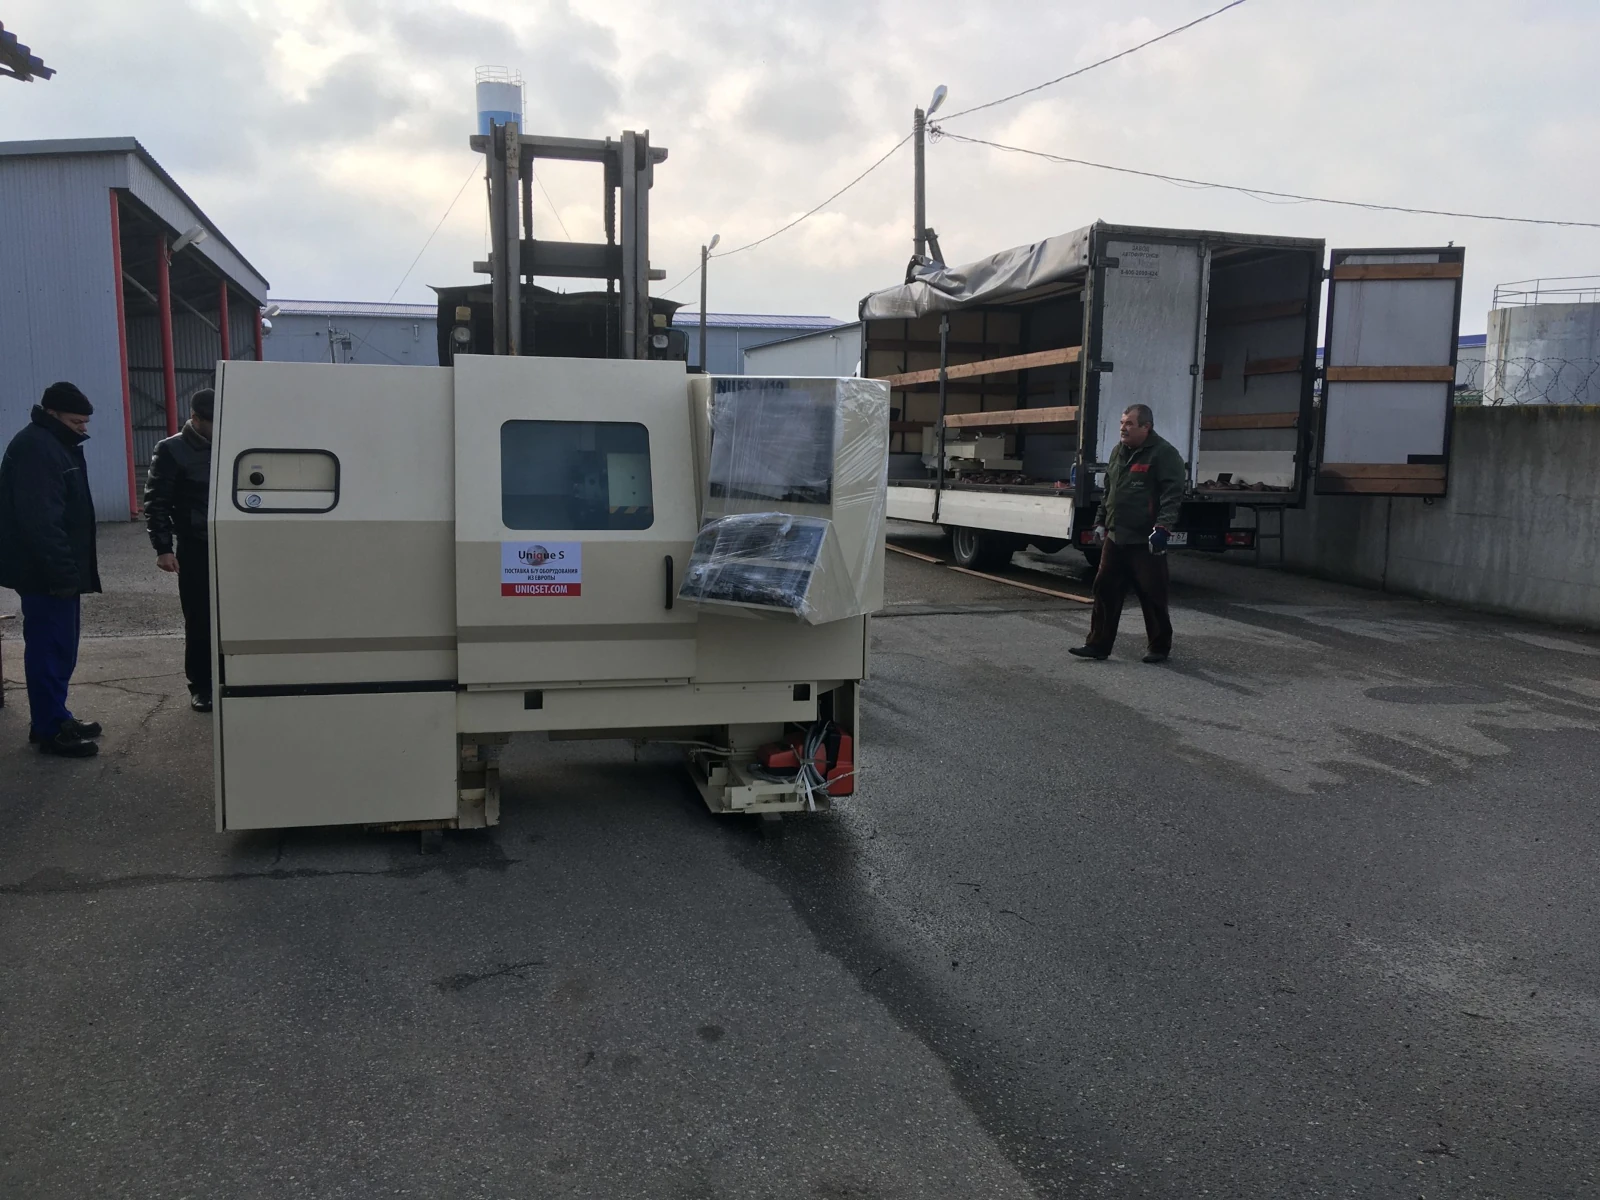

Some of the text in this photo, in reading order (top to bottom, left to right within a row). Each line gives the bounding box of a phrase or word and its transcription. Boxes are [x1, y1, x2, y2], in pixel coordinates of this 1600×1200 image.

[518, 550, 565, 561] Unique S
[515, 584, 567, 594] UNIQSET.COM
